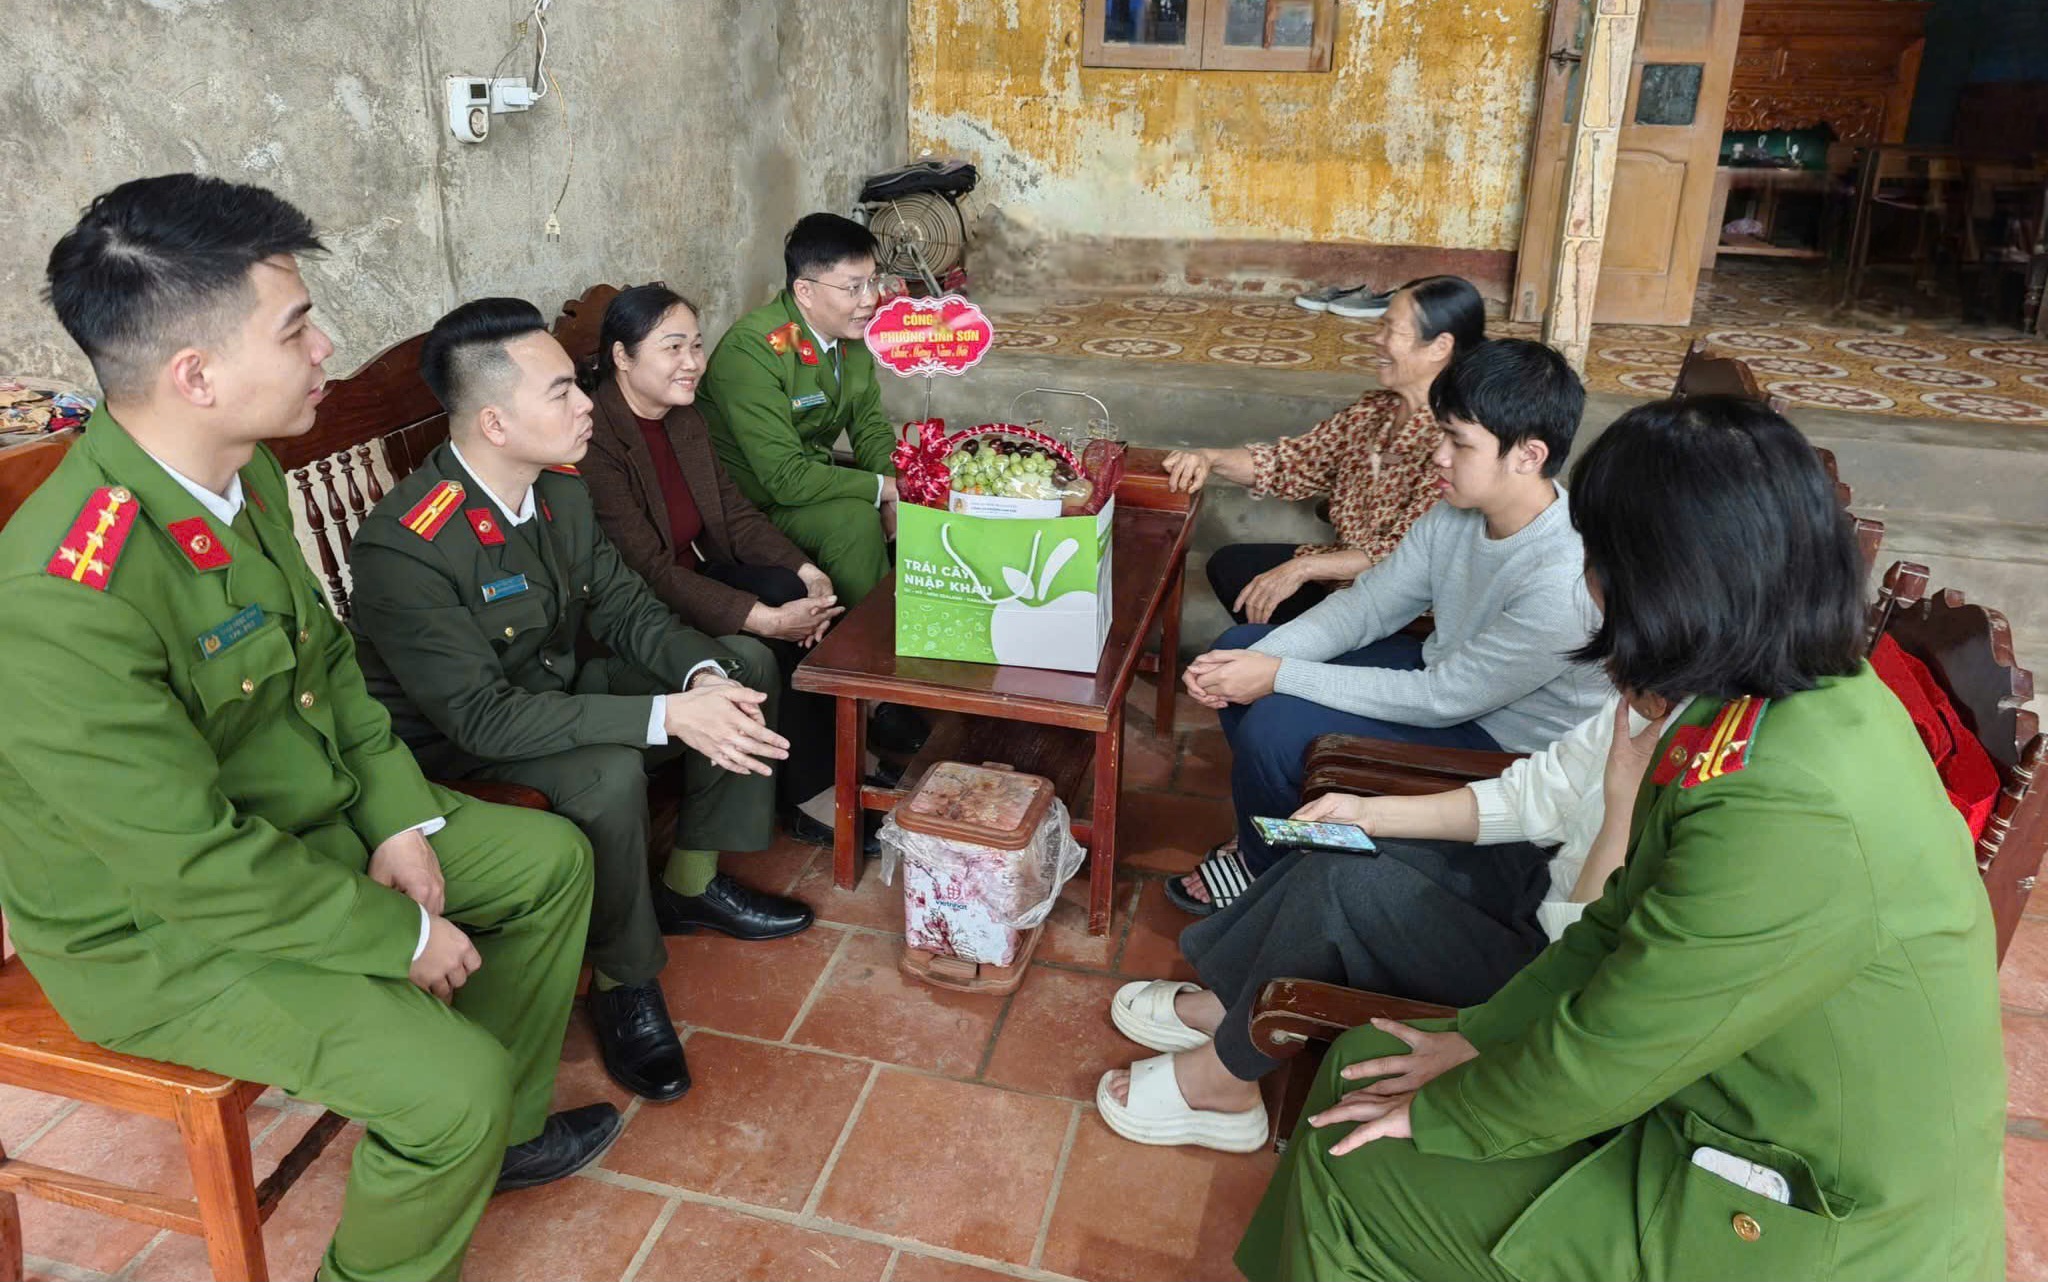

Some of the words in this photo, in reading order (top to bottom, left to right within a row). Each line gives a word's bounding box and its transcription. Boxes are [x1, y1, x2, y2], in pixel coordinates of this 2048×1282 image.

[903, 312, 933, 326] CÔNG
[928, 331, 954, 342] LINH
[956, 329, 979, 342] SƠN
[904, 559, 936, 574] TRÁI
[941, 566, 971, 579] CÂY
[904, 574, 944, 591] NHẬP
